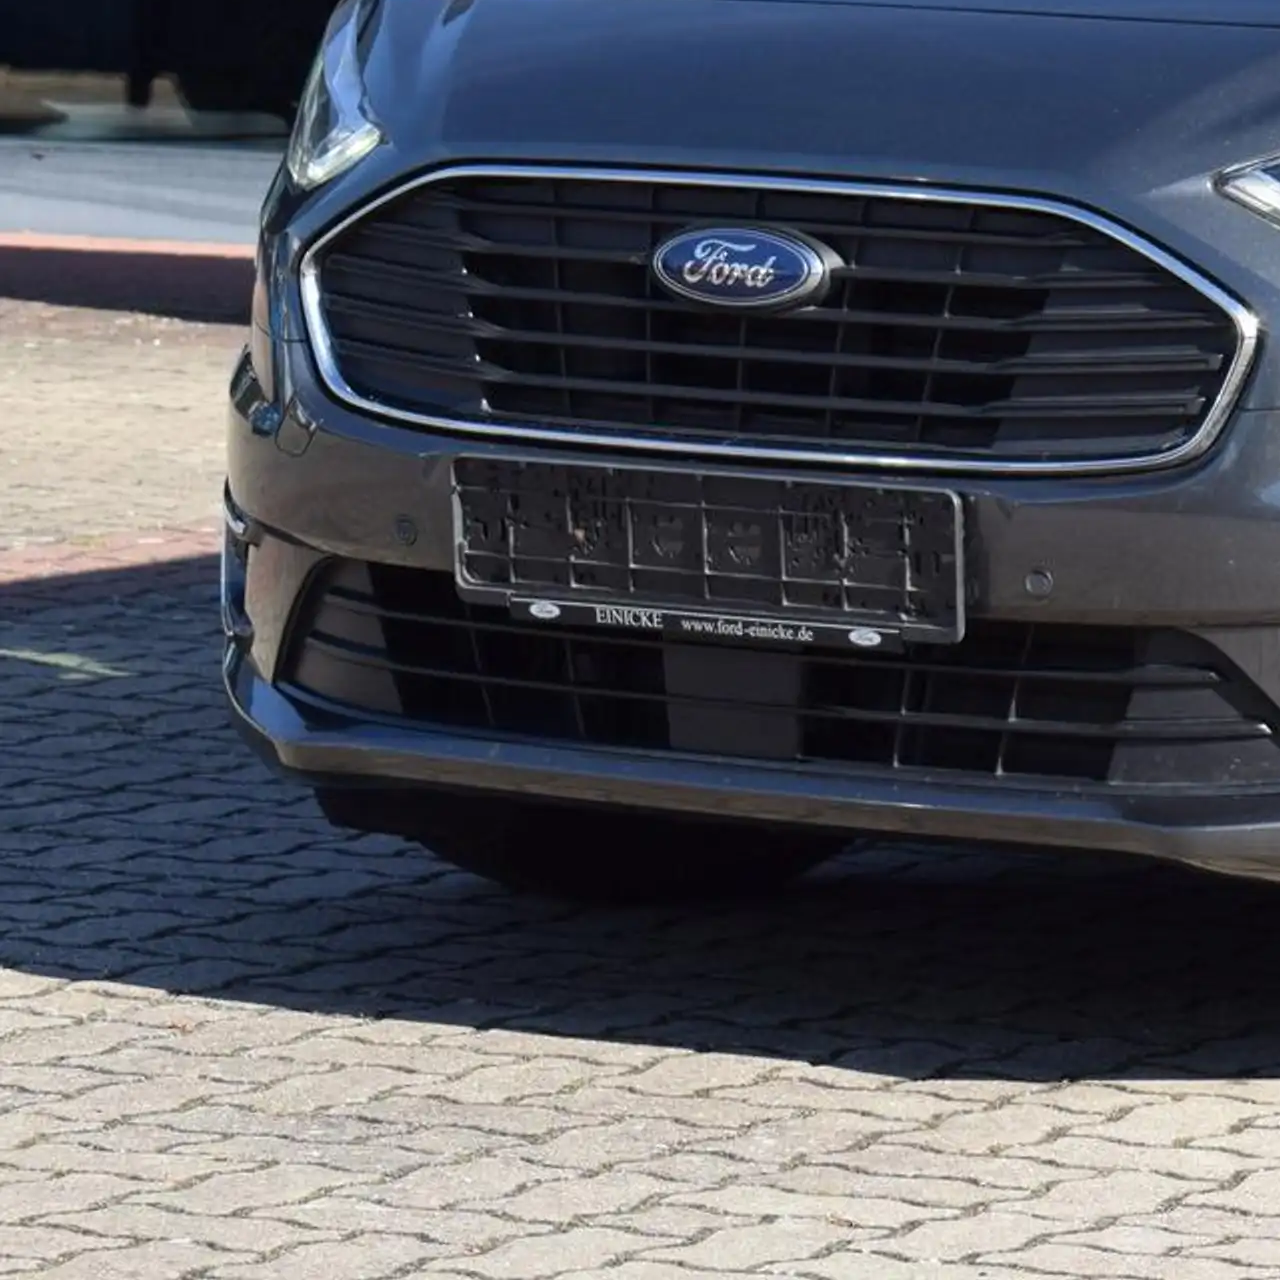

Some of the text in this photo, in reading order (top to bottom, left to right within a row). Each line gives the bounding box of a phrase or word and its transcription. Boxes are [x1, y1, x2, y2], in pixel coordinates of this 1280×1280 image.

[683, 239, 775, 288] Ford
[595, 606, 815, 642] EINICKE www.ford-einicke.de
